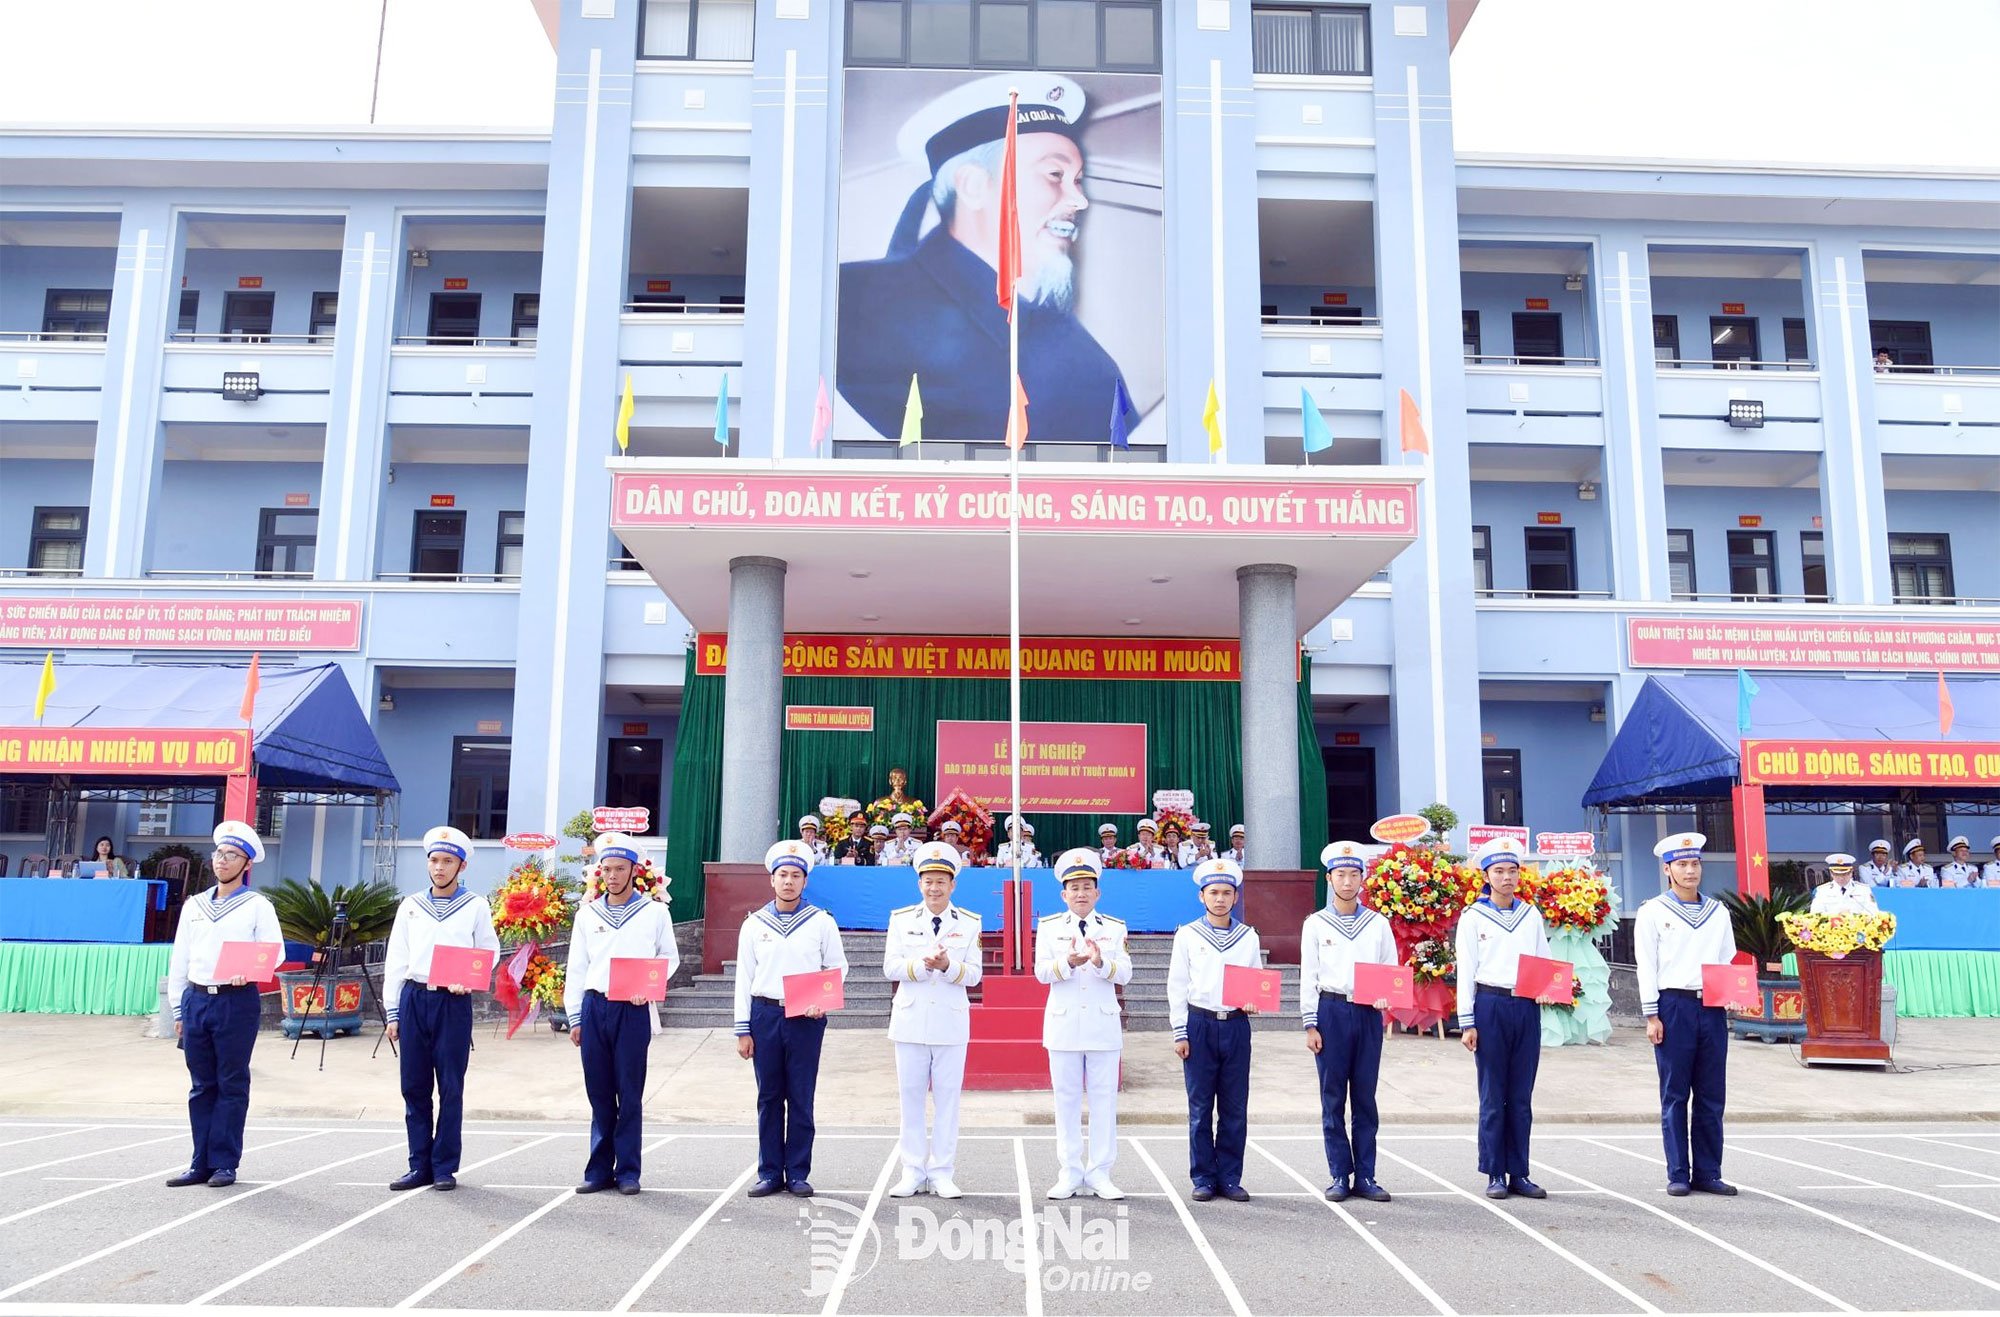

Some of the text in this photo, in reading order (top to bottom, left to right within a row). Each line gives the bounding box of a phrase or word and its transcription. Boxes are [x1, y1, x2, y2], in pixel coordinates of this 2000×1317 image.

[625, 482, 1405, 527] DÂN CHỦ, ĐOÀN KẾT, KỶ CƯƠNG, SÁNG TẠO, QUYẾT THẮNG
[7, 604, 26, 619] SỨC
[29, 603, 58, 619] CHIẾN
[82, 604, 102, 620] CỦA
[104, 605, 123, 620] CÁC
[126, 604, 147, 621] CẤP
[164, 605, 177, 621] TỔ
[178, 607, 204, 621] CHỨC
[206, 606, 235, 622] ĐẢNG;
[238, 607, 264, 621] PHÁT
[265, 609, 284, 622] HUY
[287, 607, 317, 622] TRÁCH
[320, 608, 351, 625] NHIỆM
[22, 625, 47, 641] VIÊN;
[49, 626, 69, 640] XÂY
[70, 627, 97, 642] DỰNG
[99, 625, 126, 641] ĐẢNG
[128, 627, 142, 643] BỘ
[145, 629, 176, 641] TRONG
[178, 629, 204, 643] SẠCH
[207, 627, 232, 641] VỮNG
[235, 629, 263, 644] MẠNH
[266, 627, 287, 642] TIÊU
[289, 625, 312, 642] BIỂU
[1663, 628, 1685, 642] TRIỆT
[1687, 627, 1704, 640] SÂU
[1706, 626, 1722, 640] SẮC
[1725, 628, 1749, 643] MỆNH
[1751, 628, 1774, 644] LỆNH
[1774, 626, 1797, 642] HUẤN
[1799, 628, 1824, 645] LUYỆN
[1826, 628, 1851, 643] CHIẾN
[1874, 630, 1893, 643] BÁM
[1895, 630, 1910, 644] SÁT
[1912, 631, 1946, 645] PHƯƠNG
[1947, 630, 1974, 646] CHÂM,
[1976, 633, 1994, 647] MỤC
[783, 638, 1231, 674] CỘNG SẢN VIỆT NAM QUANG VINH MUÔN
[1692, 646, 1720, 662] NHIỆM
[1722, 649, 1734, 662] VỤ
[1735, 645, 1758, 661] HUẤN
[1760, 648, 1788, 664] LUYỆN;
[1790, 648, 1806, 662] XÂY
[1808, 650, 1831, 664] DỰNG
[1833, 651, 1860, 663] TRUNG
[1862, 649, 1880, 662] TÂM
[1881, 650, 1904, 664] CÁCH
[1905, 651, 1932, 666] MẠNG,
[1934, 650, 1959, 665] CHÍNH
[1961, 652, 1979, 666] QUY,
[790, 710, 870, 727] TRUNG TÂM HUẤN LUYỆN
[28, 736, 84, 767] NHẬN
[90, 737, 155, 768] NHIỆM
[162, 741, 190, 768] VỤ
[196, 737, 236, 765] MỚI
[994, 738, 1008, 759] LỄ
[1039, 741, 1087, 763] NGHIỆP
[962, 764, 977, 776] TẠO
[1022, 764, 1050, 776] CHUYÊN
[1083, 765, 1107, 781] THUẬT
[1130, 767, 1136, 778] V
[1757, 747, 1799, 775] CHỦ
[1805, 749, 1865, 779] ĐỘNG,
[1870, 750, 1922, 776] SÁNG
[1927, 753, 1969, 780] TẠO,
